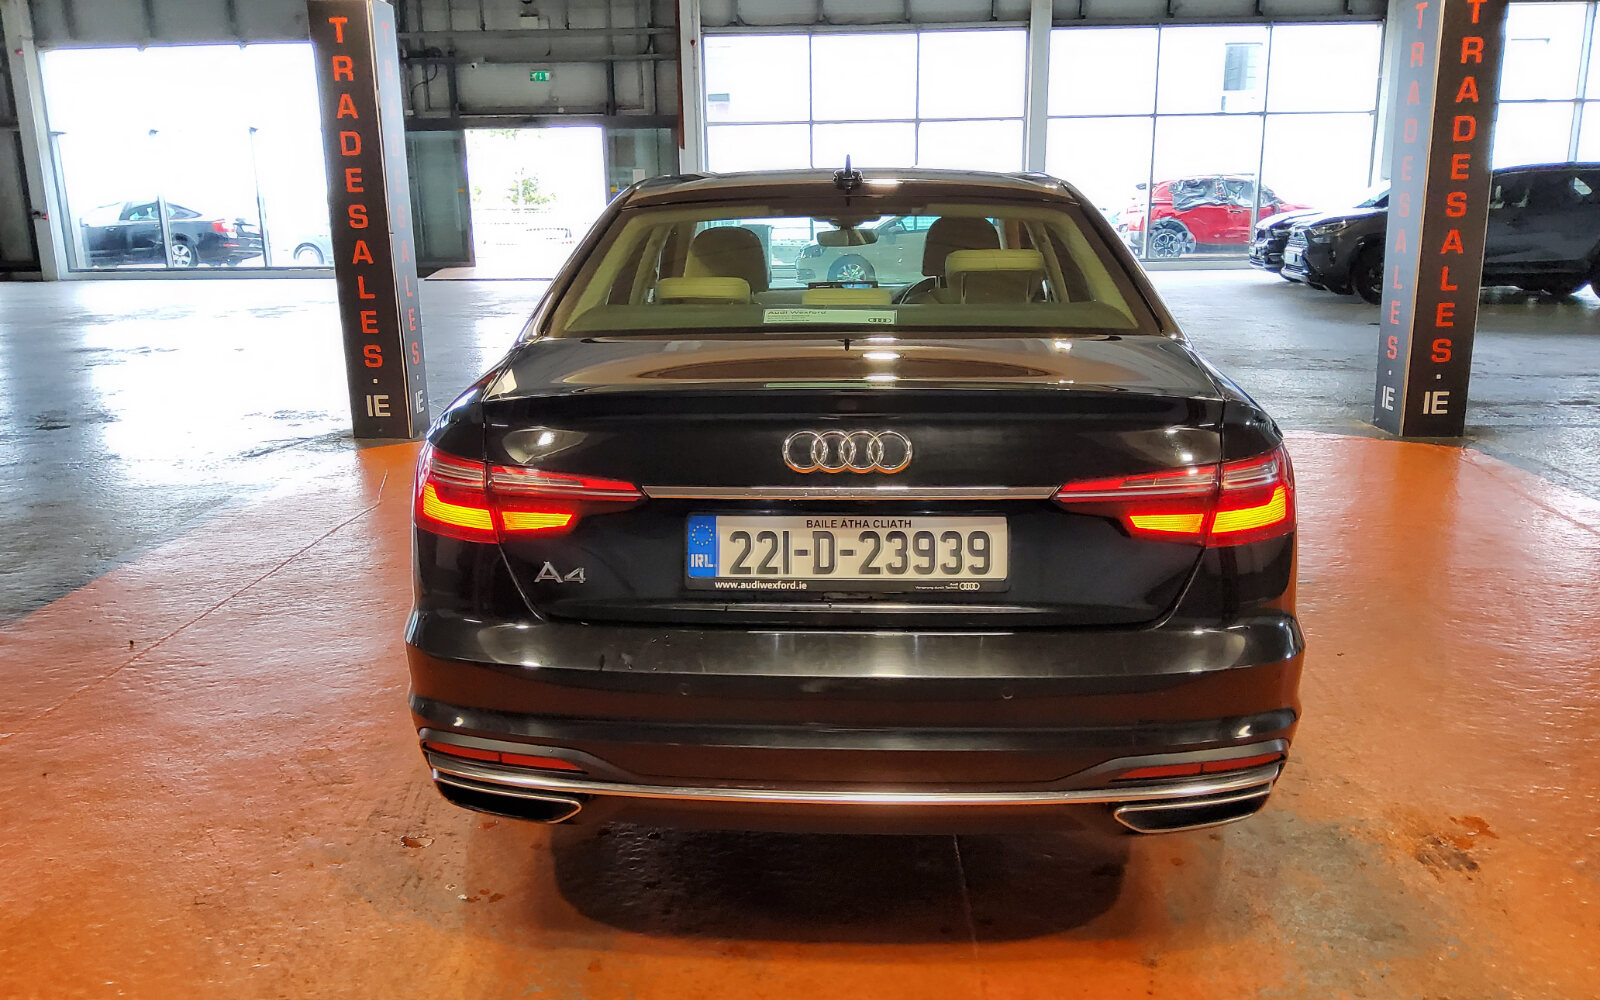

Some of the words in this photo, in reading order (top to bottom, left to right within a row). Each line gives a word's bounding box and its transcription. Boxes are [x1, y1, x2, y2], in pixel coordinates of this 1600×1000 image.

[806, 519, 838, 528] BAILE
[873, 519, 912, 528] CLIATH
[729, 530, 992, 575] 221-D-23939
[690, 554, 714, 568] IRL
[533, 561, 586, 584] A4
[715, 580, 808, 590] www.audiwexford.ie
